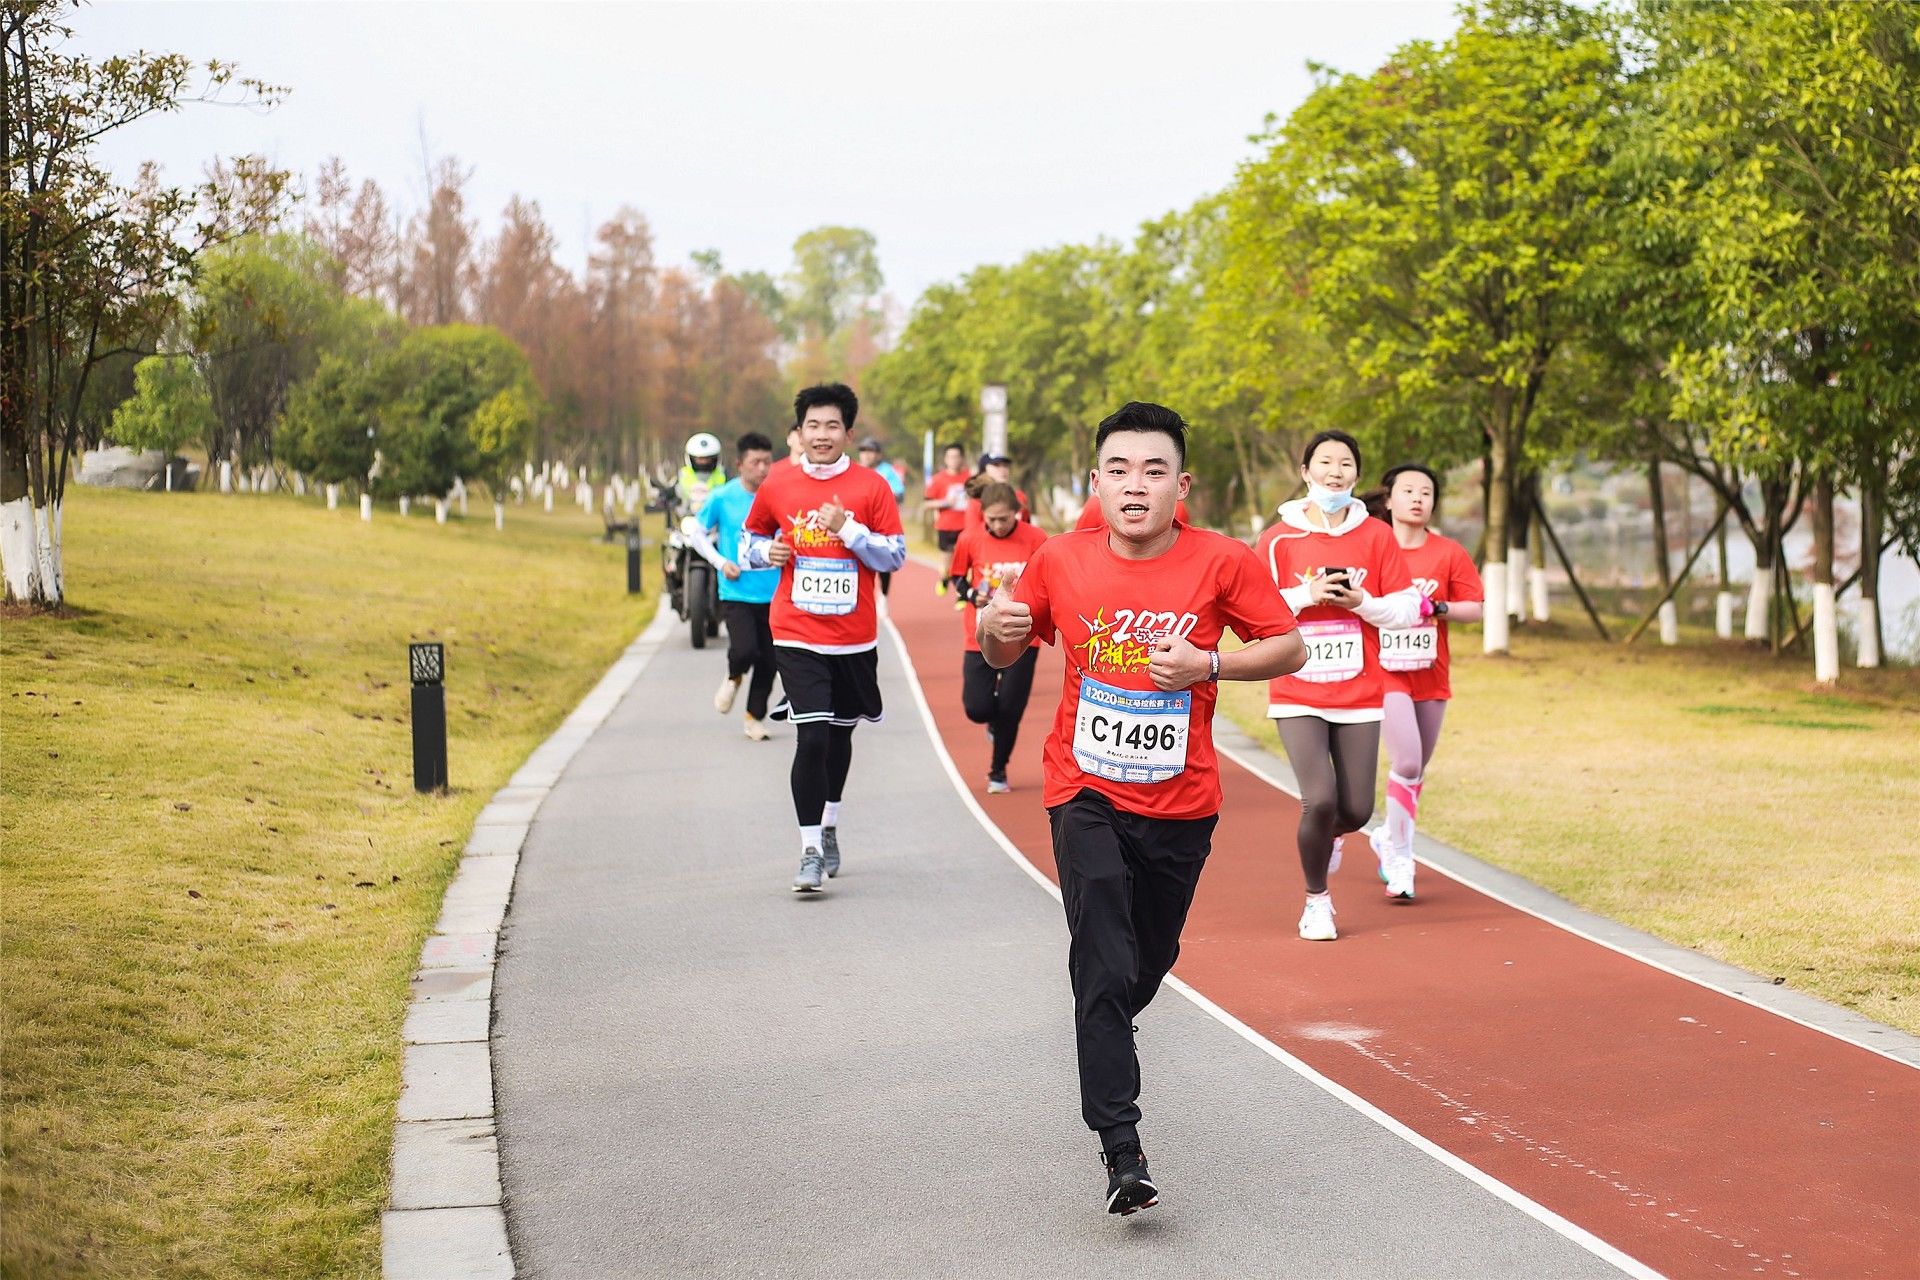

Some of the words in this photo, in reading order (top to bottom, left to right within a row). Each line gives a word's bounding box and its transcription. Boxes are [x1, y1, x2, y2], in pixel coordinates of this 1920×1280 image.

[802, 576, 851, 595] C1216
[1111, 608, 1199, 645] 2020
[1304, 641, 1354, 660] D1217
[1382, 633, 1431, 649] D1149
[1091, 715, 1176, 751] C1496
